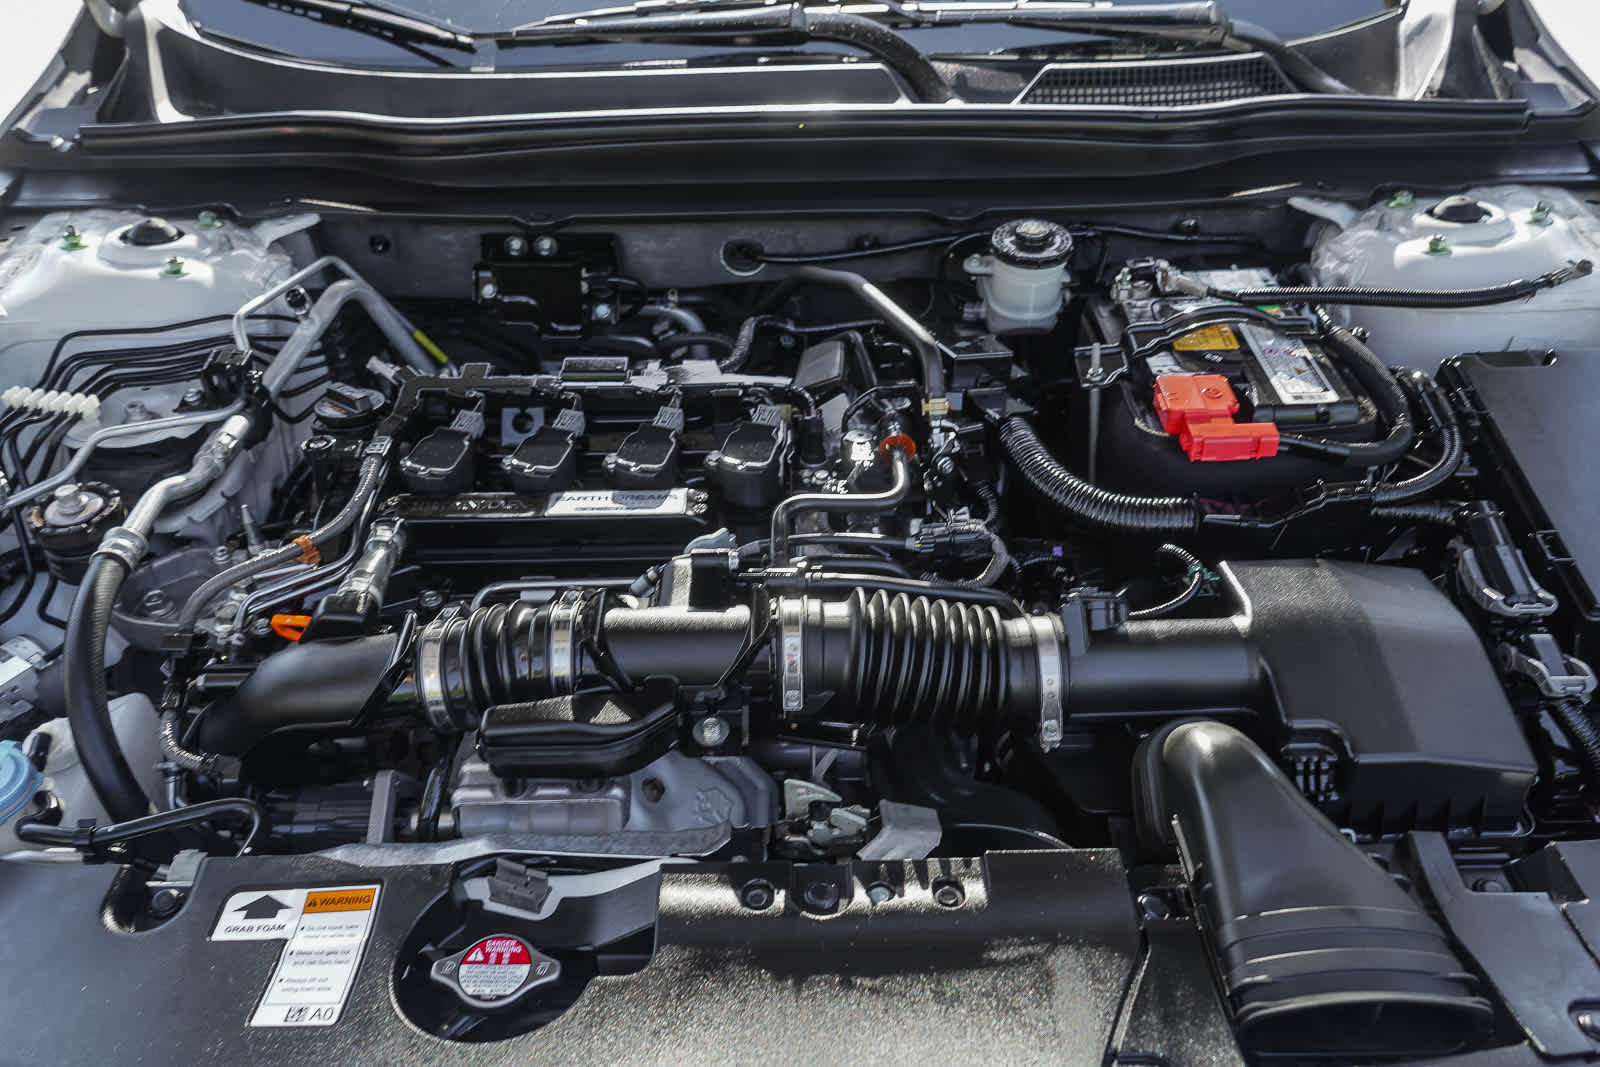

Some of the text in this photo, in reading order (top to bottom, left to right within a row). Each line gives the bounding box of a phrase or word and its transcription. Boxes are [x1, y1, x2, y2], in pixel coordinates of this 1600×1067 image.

[320, 894, 370, 907] WARNING
[223, 923, 287, 934] GRAB FOAM
[485, 944, 523, 953] WARNING
